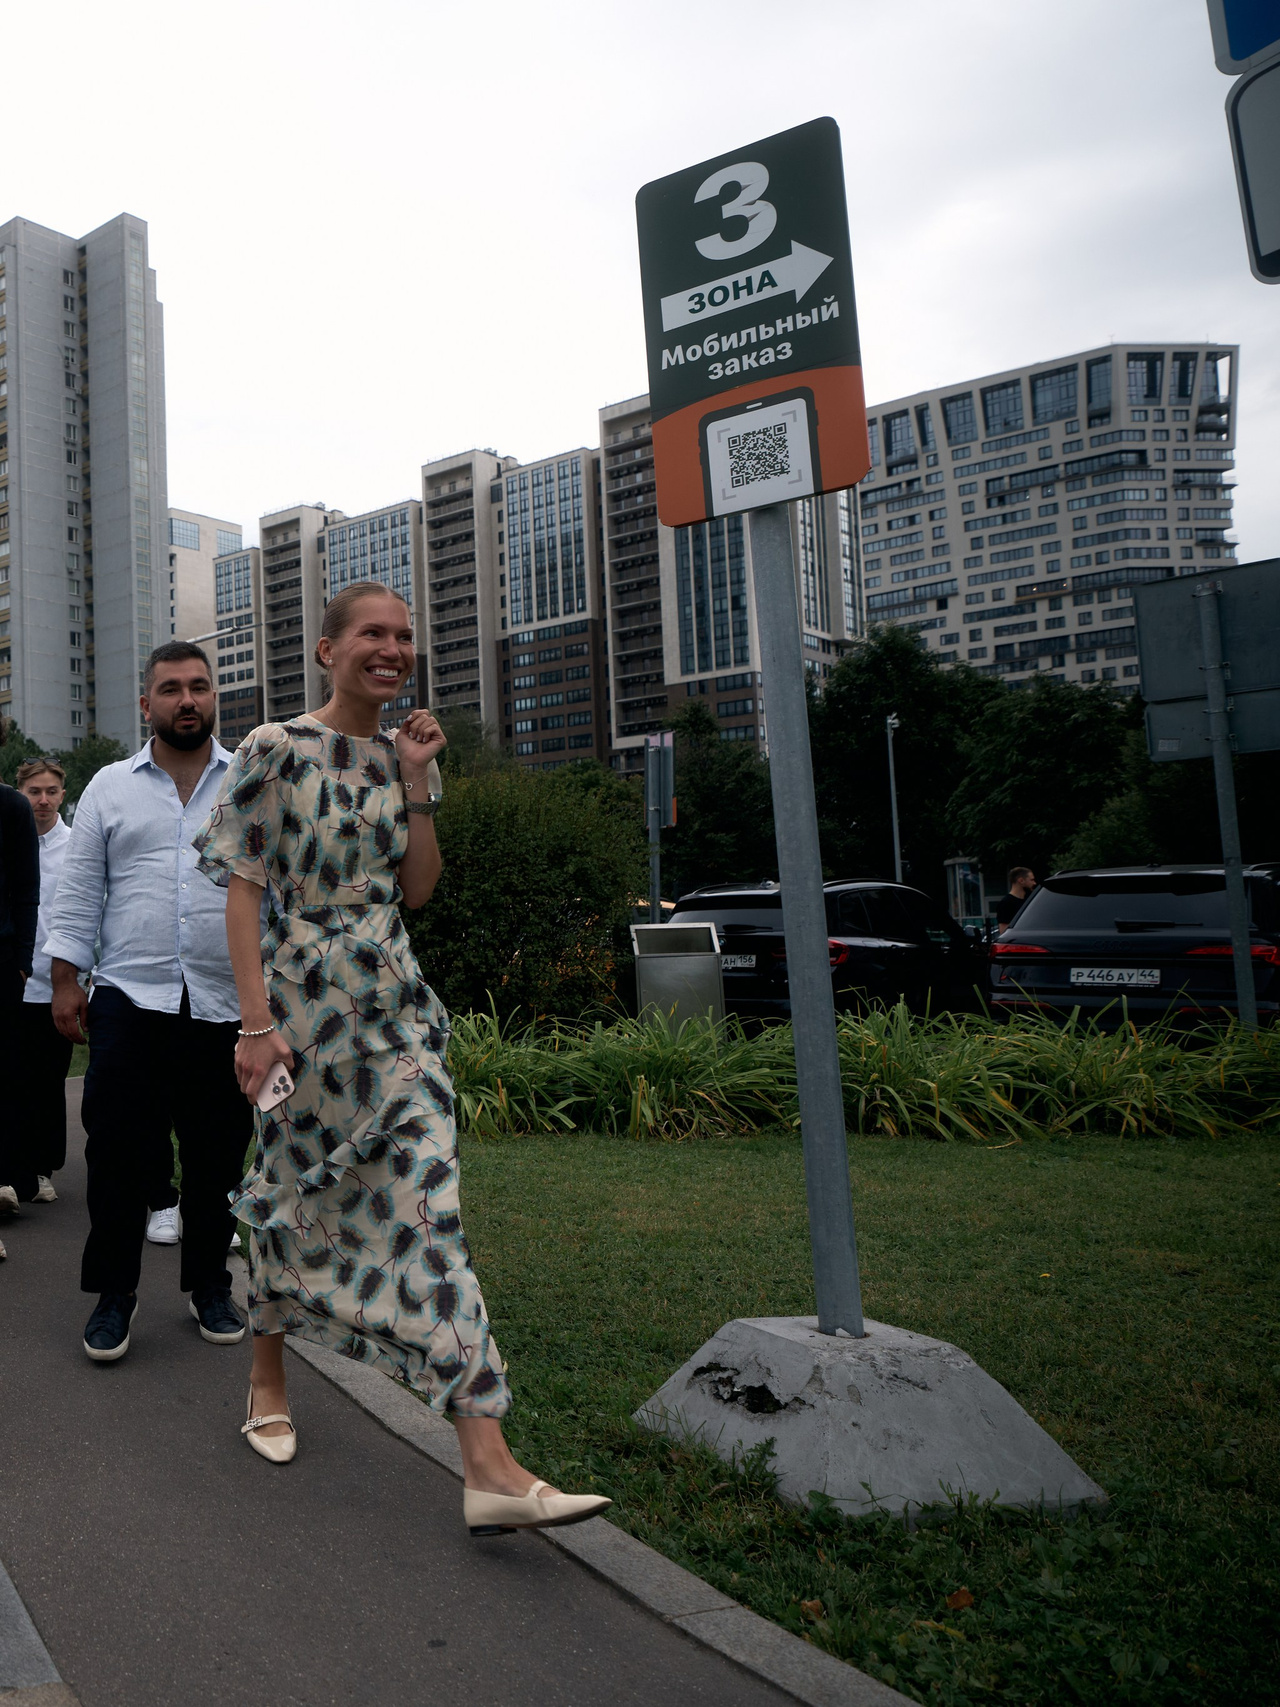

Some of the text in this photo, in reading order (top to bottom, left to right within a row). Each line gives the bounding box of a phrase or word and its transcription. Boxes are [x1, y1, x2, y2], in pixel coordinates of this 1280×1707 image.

[694, 161, 777, 261] 3
[687, 270, 778, 315] ЗОНА
[661, 295, 840, 370] Мобильный
[708, 342, 793, 380] заказ
